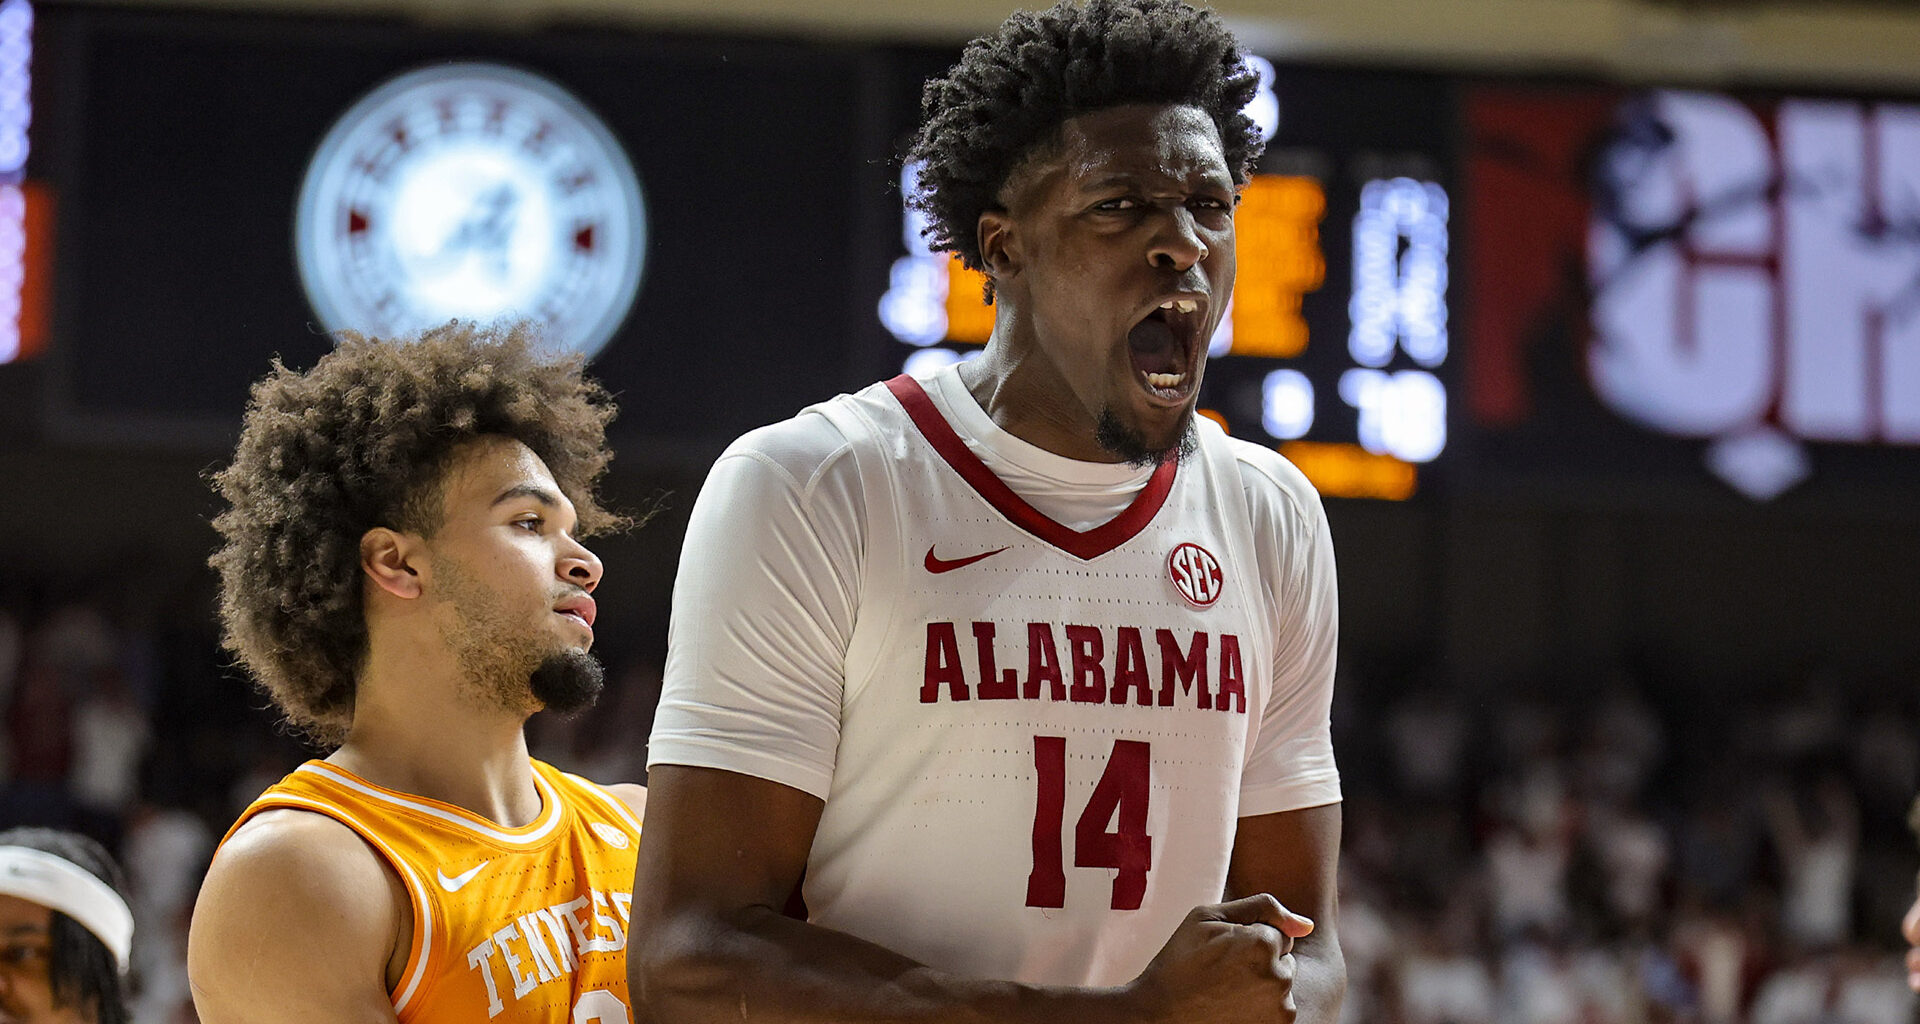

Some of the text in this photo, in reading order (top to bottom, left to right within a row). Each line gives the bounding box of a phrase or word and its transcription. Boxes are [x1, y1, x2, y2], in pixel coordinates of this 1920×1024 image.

[1172, 546, 1220, 602] SEC
[920, 621, 1247, 714] ALABAMA
[1025, 735, 1152, 911] 14
